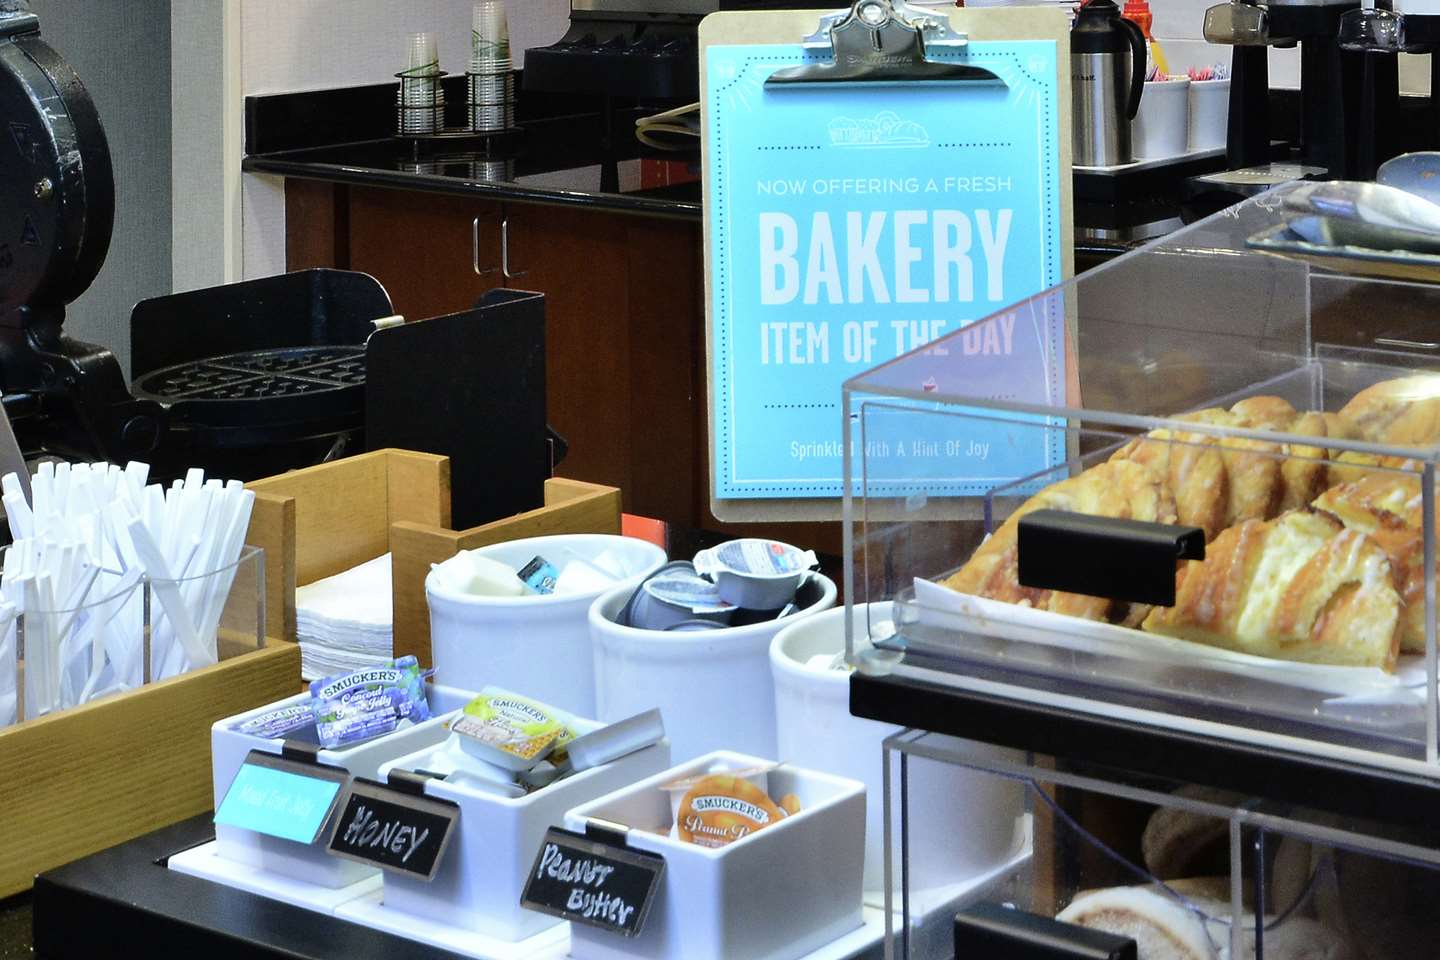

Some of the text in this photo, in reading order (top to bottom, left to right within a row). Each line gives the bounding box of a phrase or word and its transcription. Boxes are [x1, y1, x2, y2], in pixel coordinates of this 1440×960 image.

[757, 176, 1012, 196] NOW OFFERING A FRESH
[759, 208, 1014, 306] BAKERY
[760, 313, 1016, 365] ITEM OF THE DAY
[966, 441, 990, 460] Joy
[324, 670, 398, 697] SMUCKER'S
[695, 797, 764, 821] SMUCKER'S
